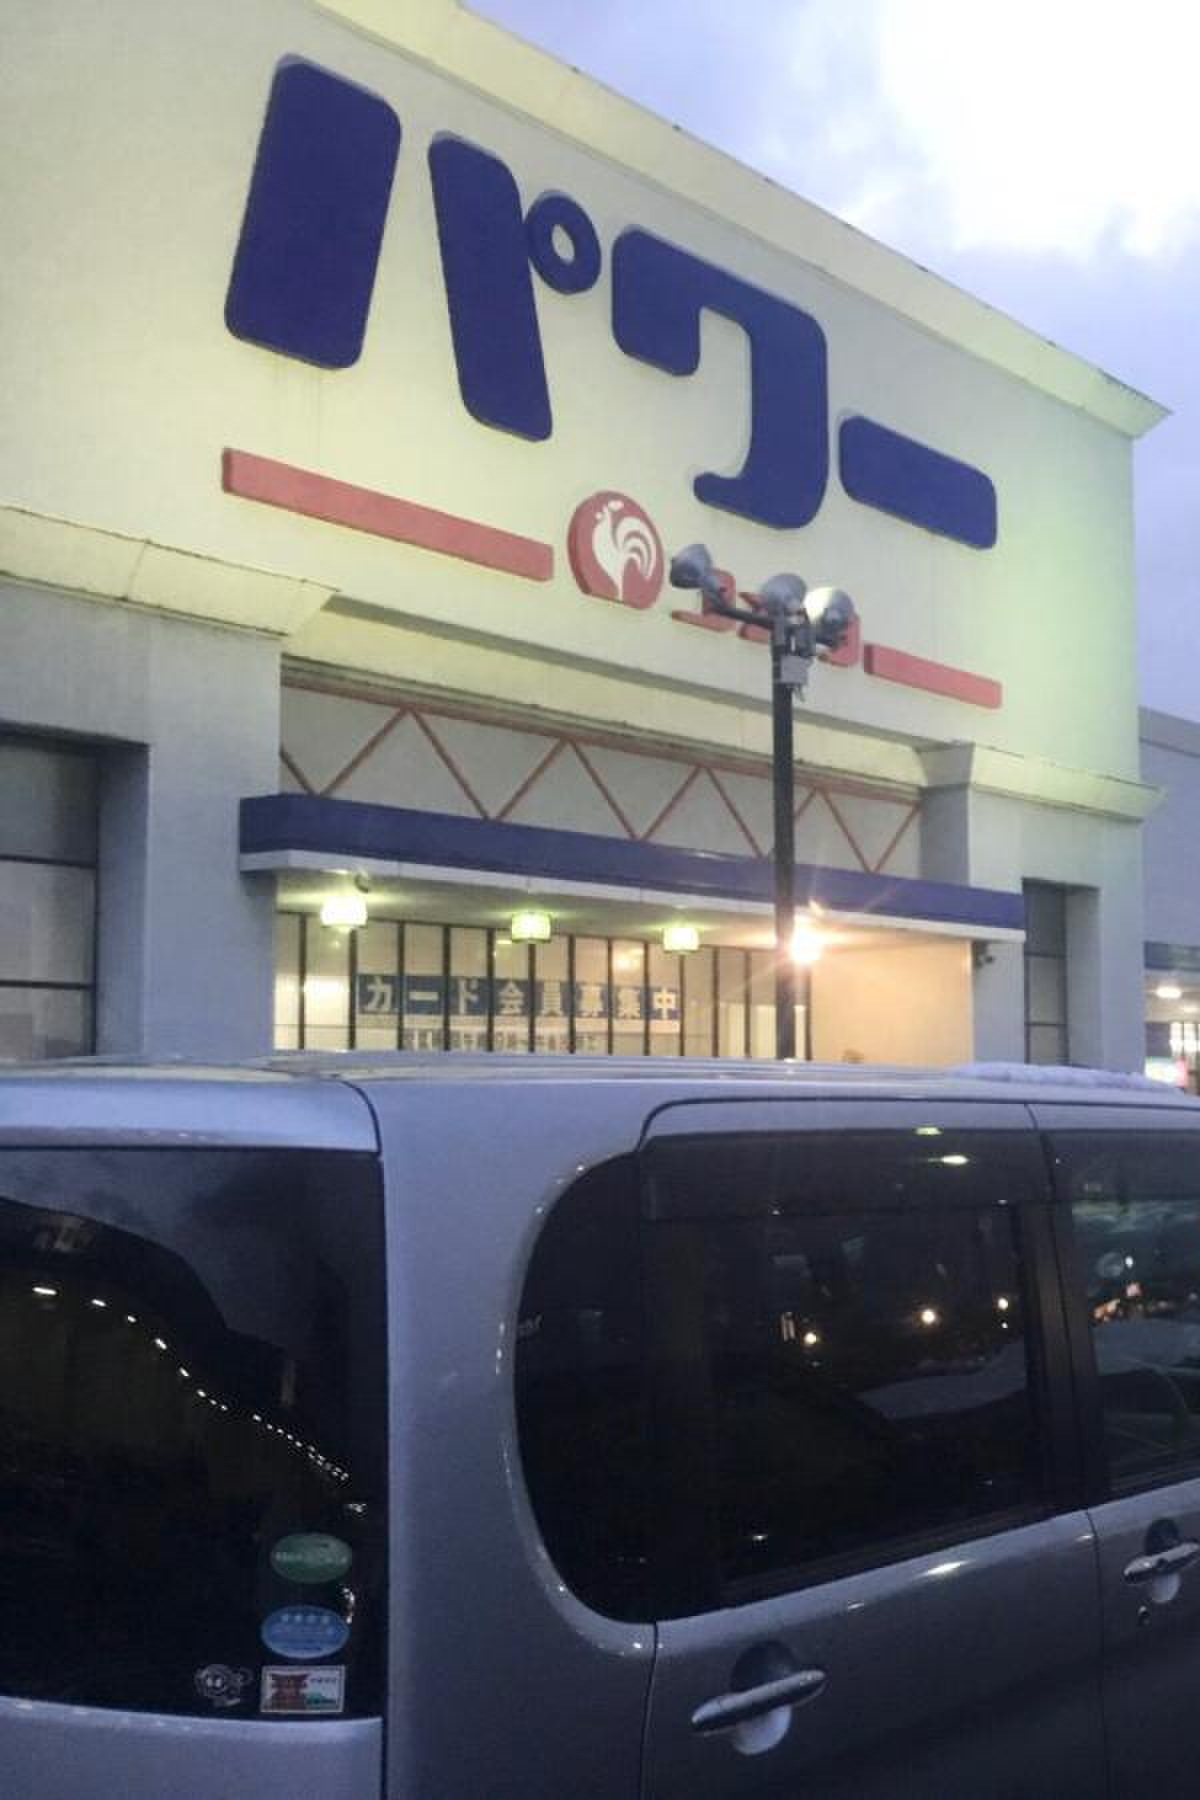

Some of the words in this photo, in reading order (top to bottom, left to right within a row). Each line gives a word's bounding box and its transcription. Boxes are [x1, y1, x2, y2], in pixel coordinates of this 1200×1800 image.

[224, 54, 997, 549] パワー
[364, 975, 677, 1020] カード会員募集中
